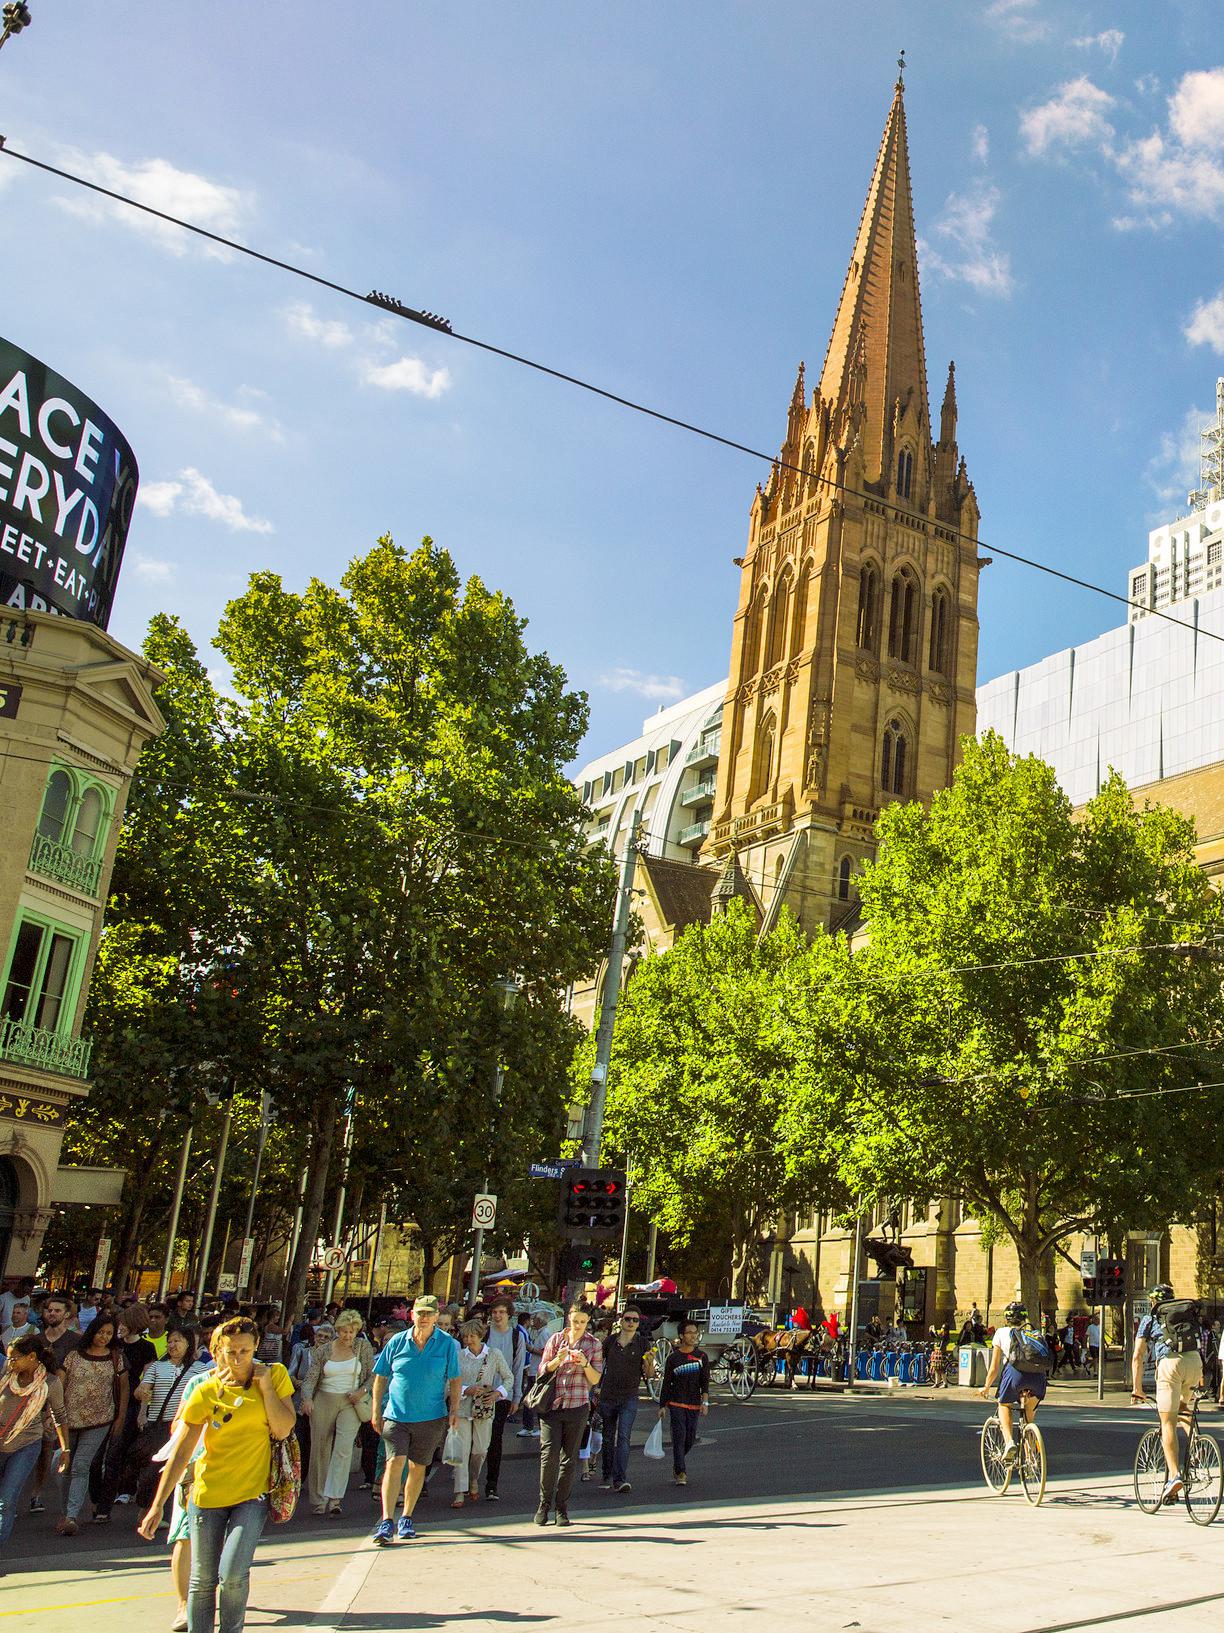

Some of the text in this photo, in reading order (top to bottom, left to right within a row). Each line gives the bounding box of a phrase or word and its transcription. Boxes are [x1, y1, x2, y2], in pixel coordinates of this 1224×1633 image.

[0, 520, 48, 570] EET
[53, 557, 87, 601] EAT
[531, 1163, 559, 1175] Flinders
[477, 1205, 493, 1217] 30
